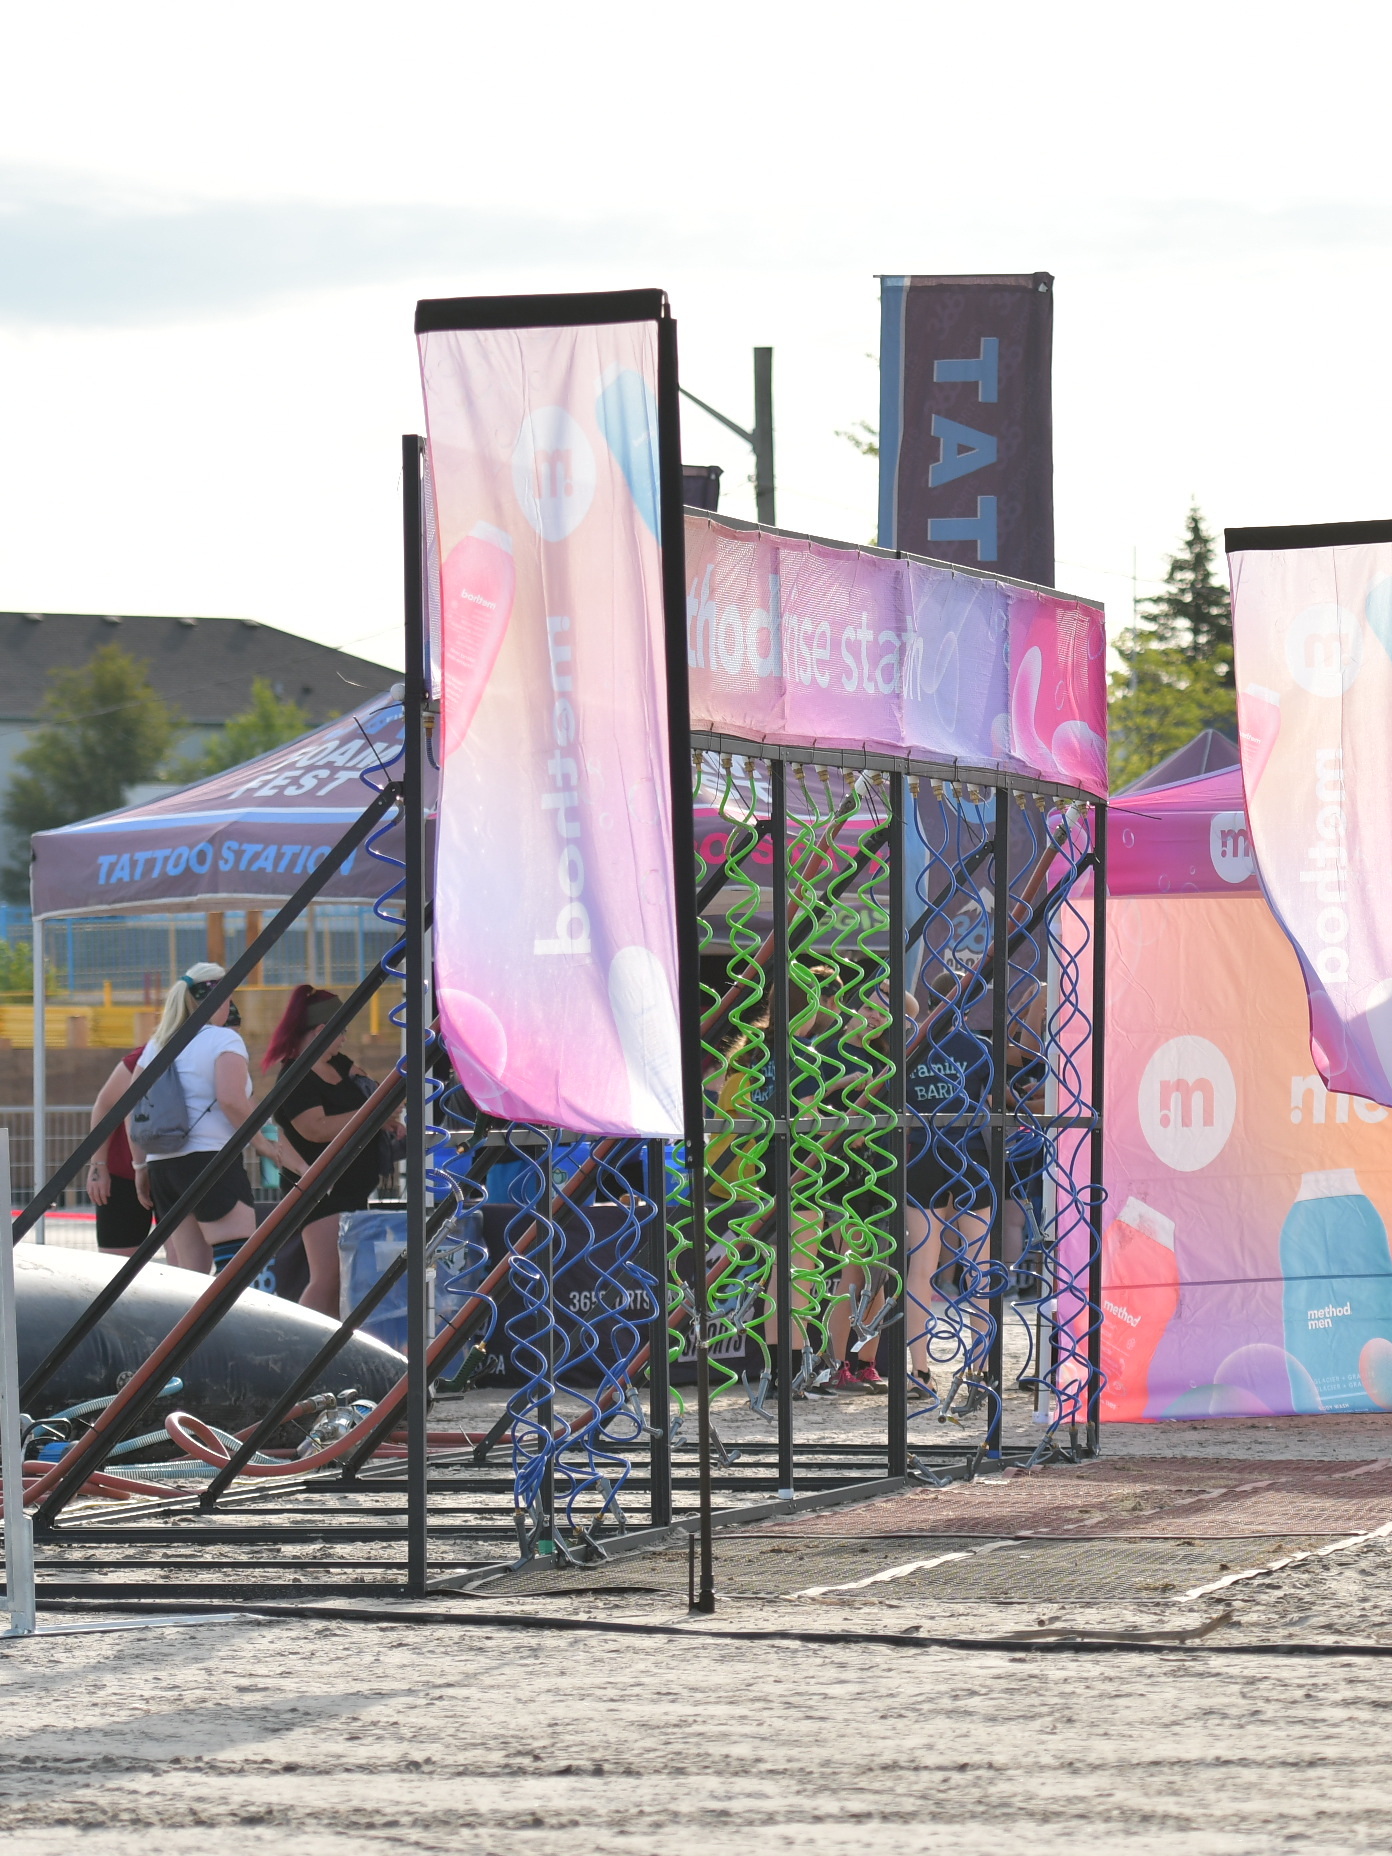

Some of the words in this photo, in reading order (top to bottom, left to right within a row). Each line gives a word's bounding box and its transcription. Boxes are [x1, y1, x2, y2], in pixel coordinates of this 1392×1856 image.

[686, 563, 783, 678] thod
[228, 768, 361, 801] FEST
[96, 842, 214, 885] TATTOO
[1103, 1299, 1142, 1328] method
[1307, 1302, 1352, 1319] method
[1308, 1317, 1333, 1330] men
[1319, 1383, 1341, 1392] LACIER
